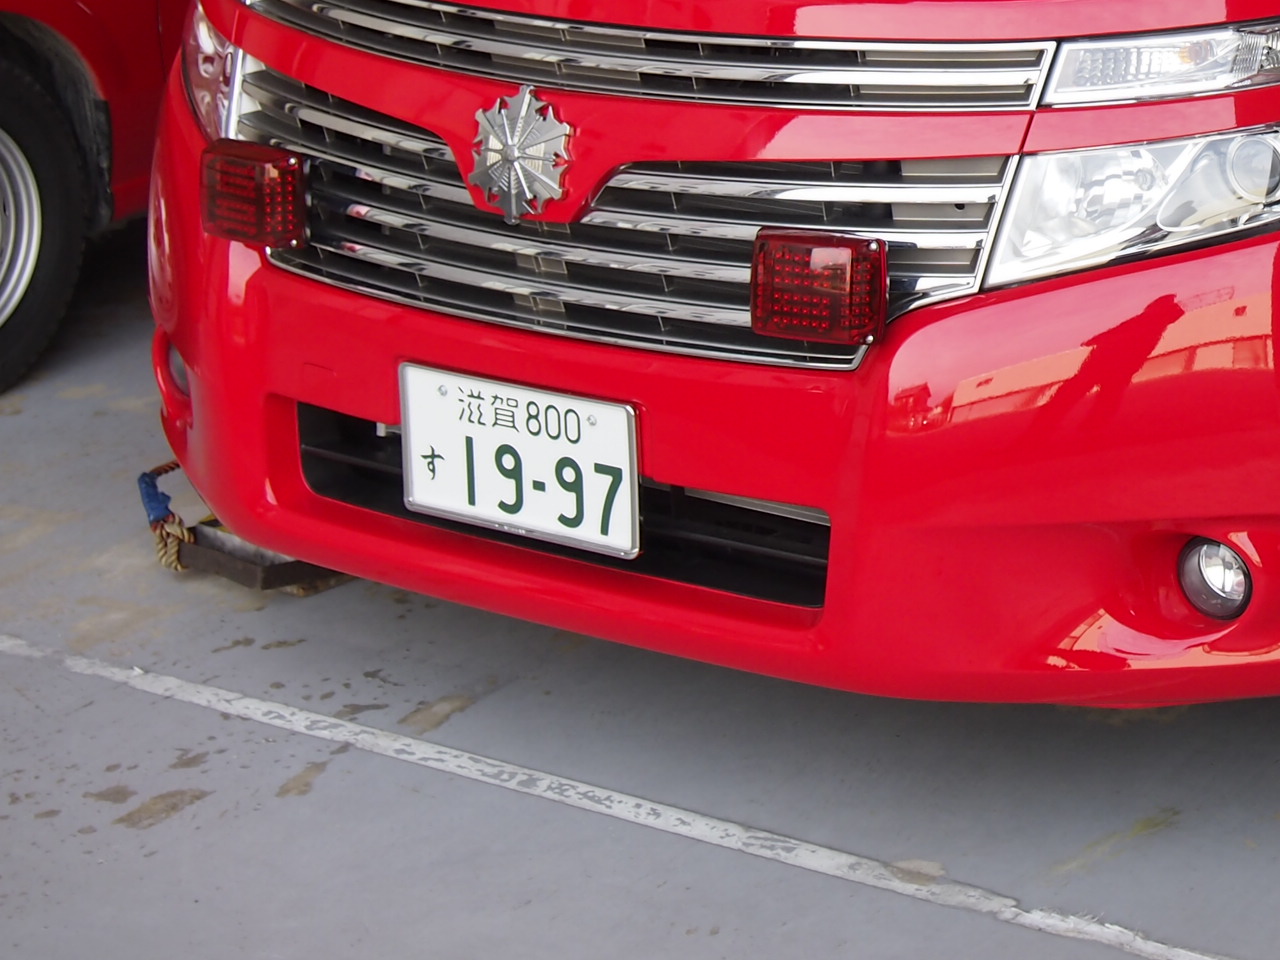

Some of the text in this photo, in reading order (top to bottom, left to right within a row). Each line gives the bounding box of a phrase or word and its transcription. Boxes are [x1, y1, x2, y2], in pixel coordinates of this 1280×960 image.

[457, 386, 581, 444] 滋賀800
[421, 435, 623, 537] す 19-97
